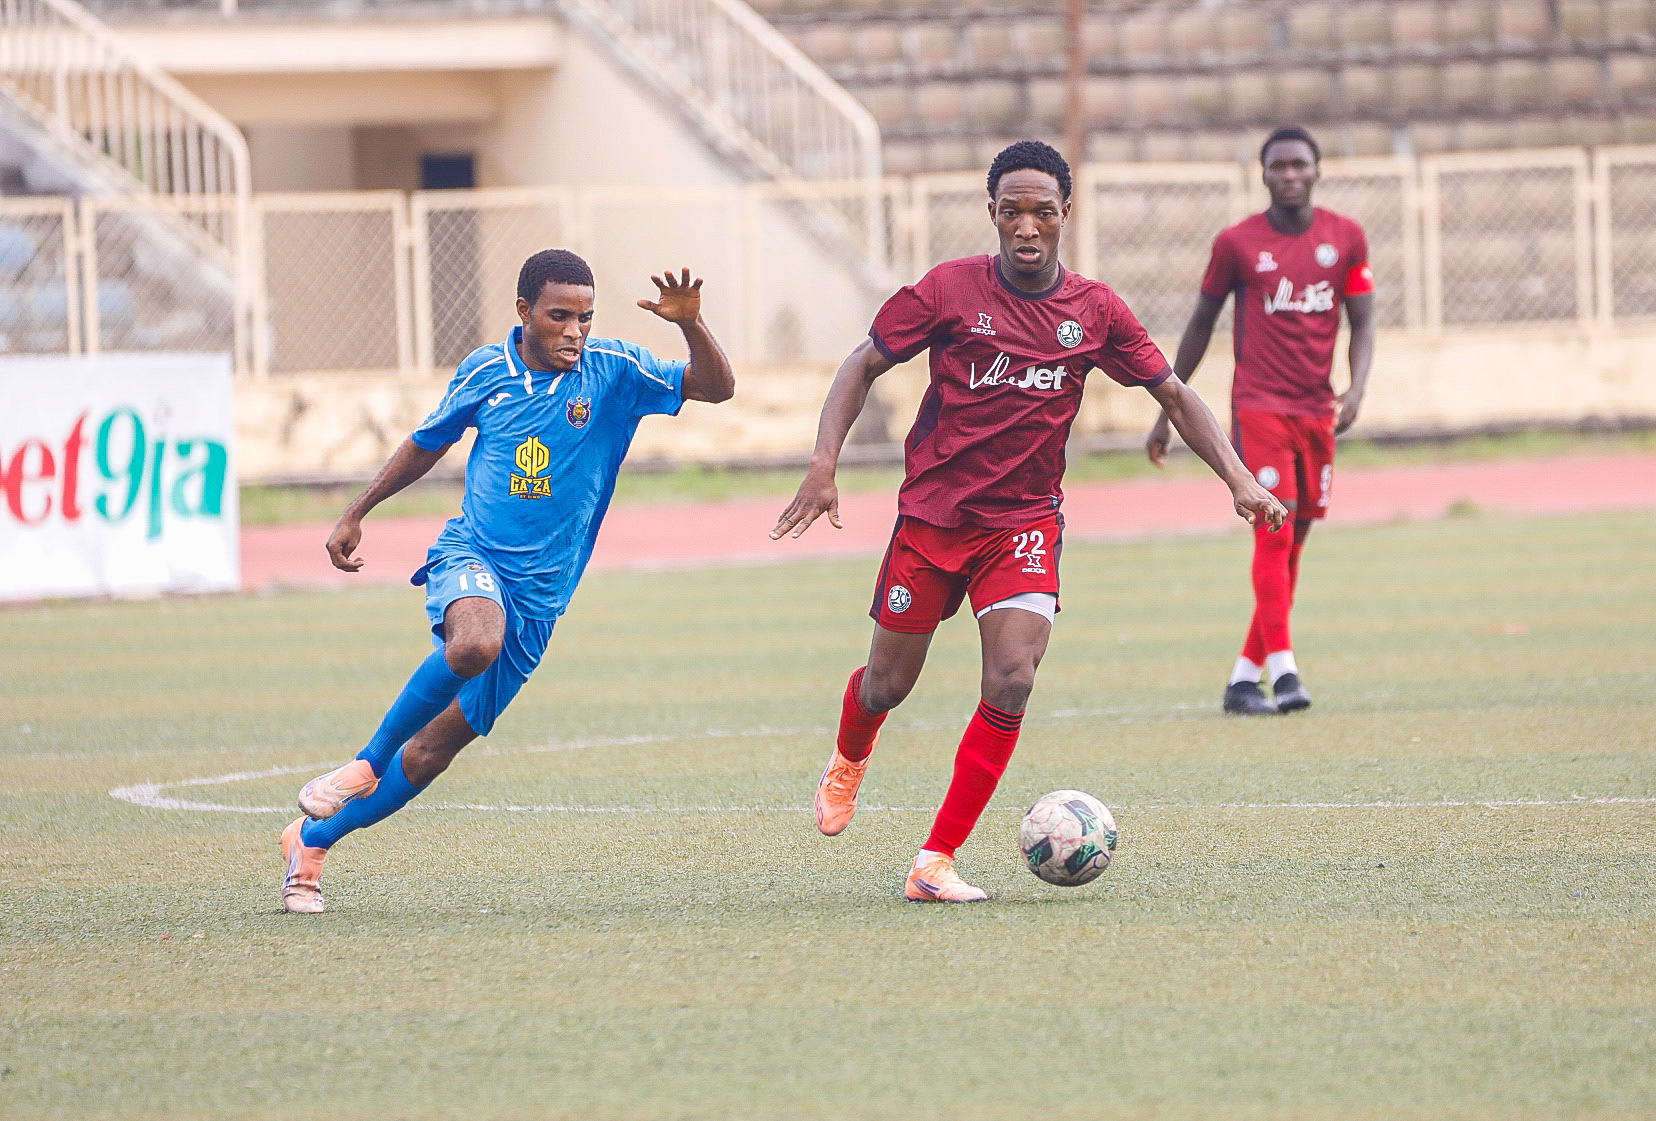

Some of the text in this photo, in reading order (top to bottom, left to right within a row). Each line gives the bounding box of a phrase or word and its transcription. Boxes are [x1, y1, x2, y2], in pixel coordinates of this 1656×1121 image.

[0, 404, 227, 543] et9ja
[1012, 530, 1047, 558] 22
[458, 572, 495, 592] 18
